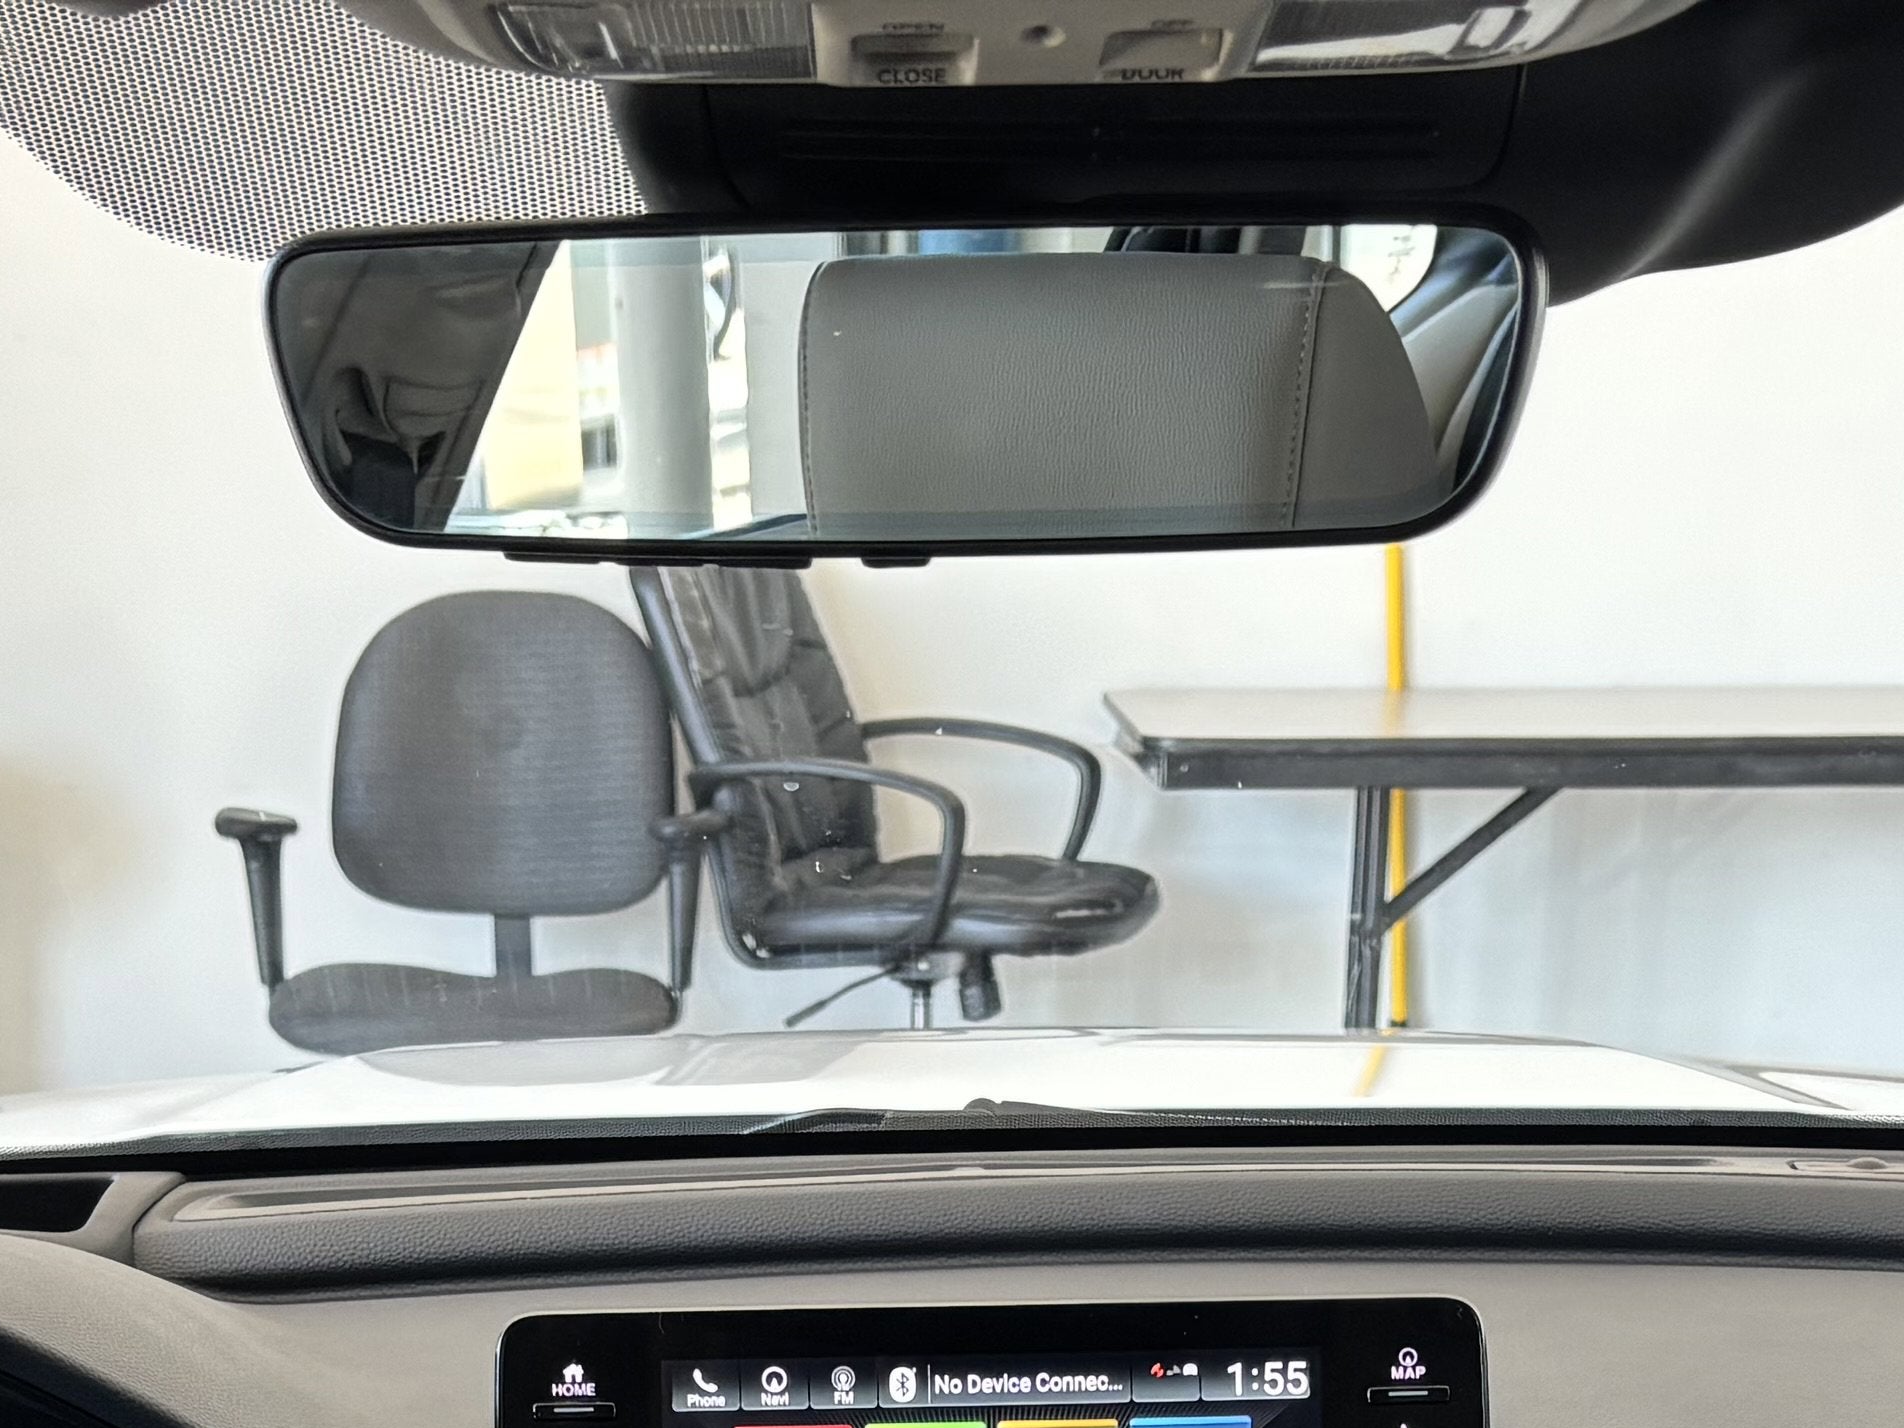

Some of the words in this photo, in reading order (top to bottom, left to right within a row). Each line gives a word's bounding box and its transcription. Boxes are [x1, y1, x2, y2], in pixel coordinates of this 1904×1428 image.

[878, 68, 946, 84] CLOSE
[1227, 1360, 1308, 1396] 1:55
[1391, 1366, 1426, 1380] MAP
[551, 1383, 596, 1396] HOME
[934, 1374, 962, 1394] No
[967, 1374, 1031, 1394] Device
[1035, 1371, 1123, 1393] Connec...
[687, 1394, 726, 1408] Phone
[761, 1391, 789, 1406] Navi
[834, 1391, 854, 1405] FM
